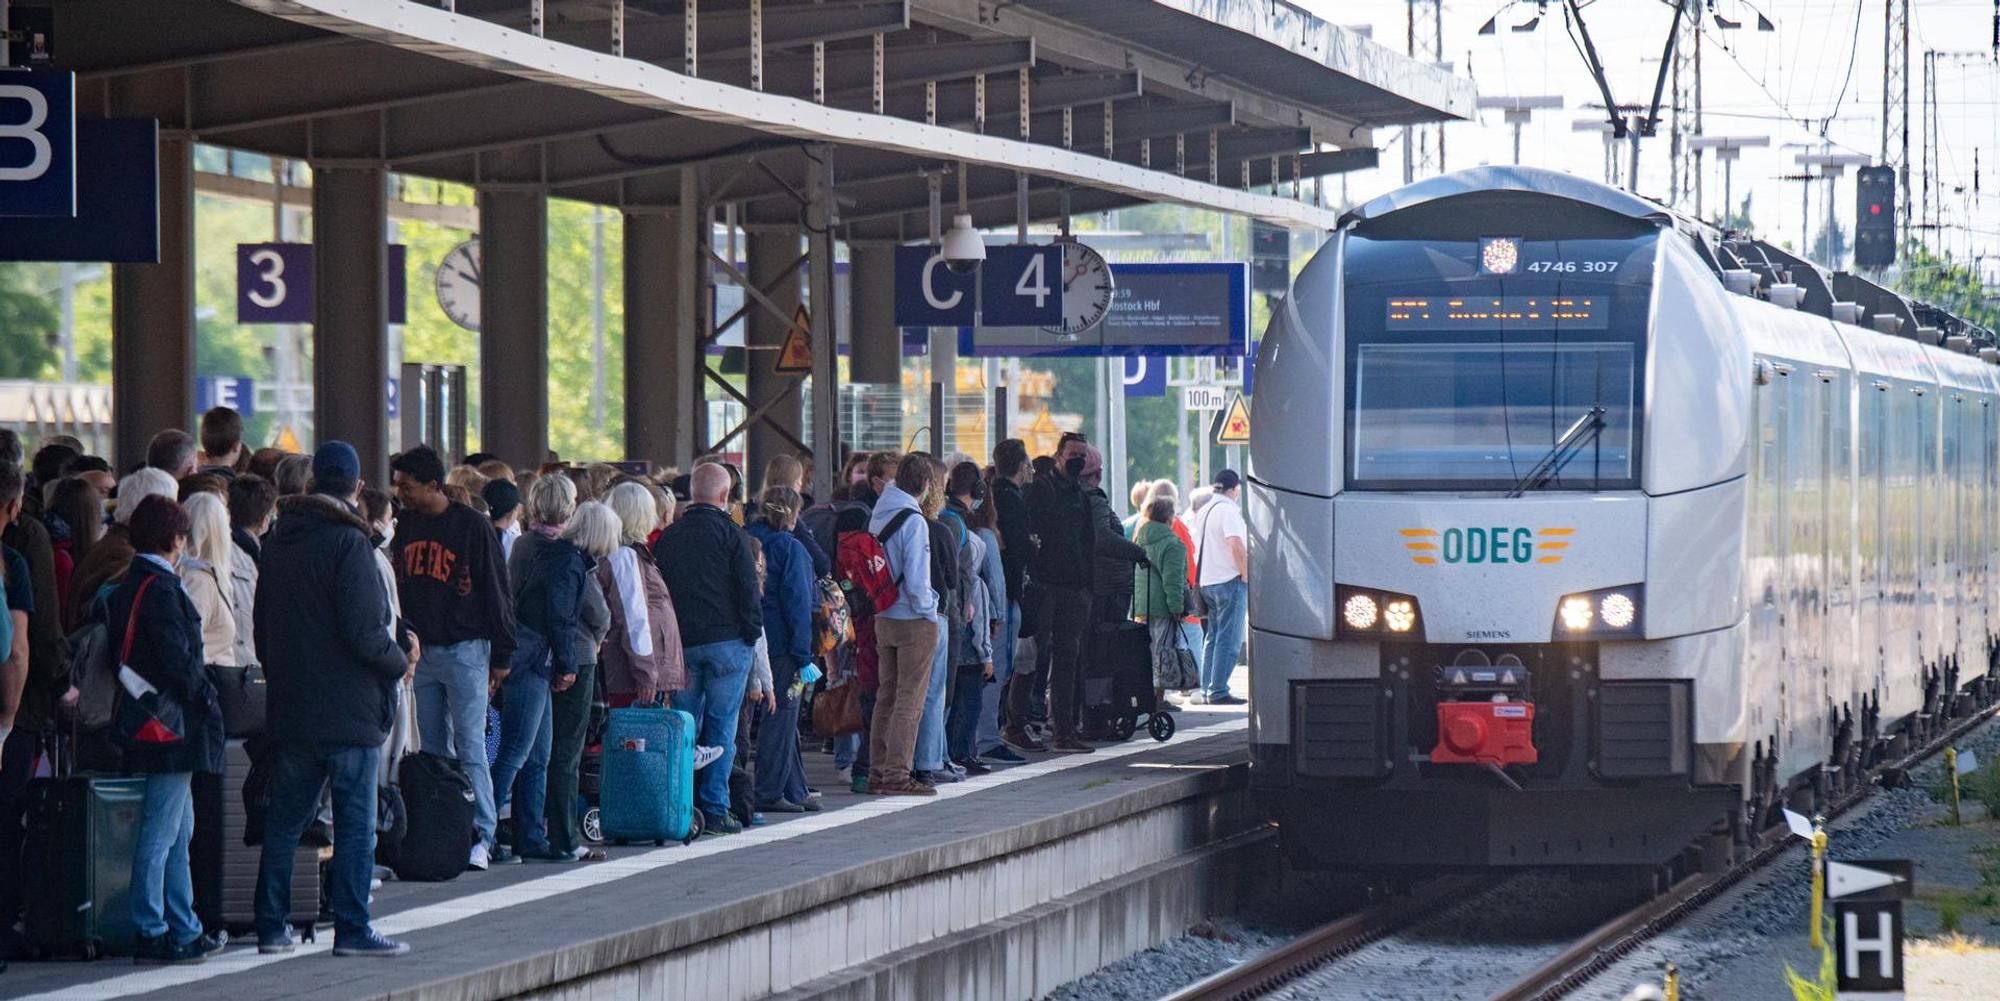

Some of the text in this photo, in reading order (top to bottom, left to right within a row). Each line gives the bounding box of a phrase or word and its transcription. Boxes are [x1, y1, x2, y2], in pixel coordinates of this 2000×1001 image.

[0, 85, 52, 181] B
[247, 250, 287, 308] 3
[921, 254, 963, 310] C
[1015, 253, 1051, 308] 4
[1527, 261, 1618, 273] 4746 307
[1144, 300, 1160, 311] Hbf
[216, 377, 239, 409] E
[1188, 391, 1221, 406] 100 m
[1443, 527, 1533, 564] ODEG
[1466, 630, 1511, 639] SIEMENS
[1843, 911, 1894, 979] H
